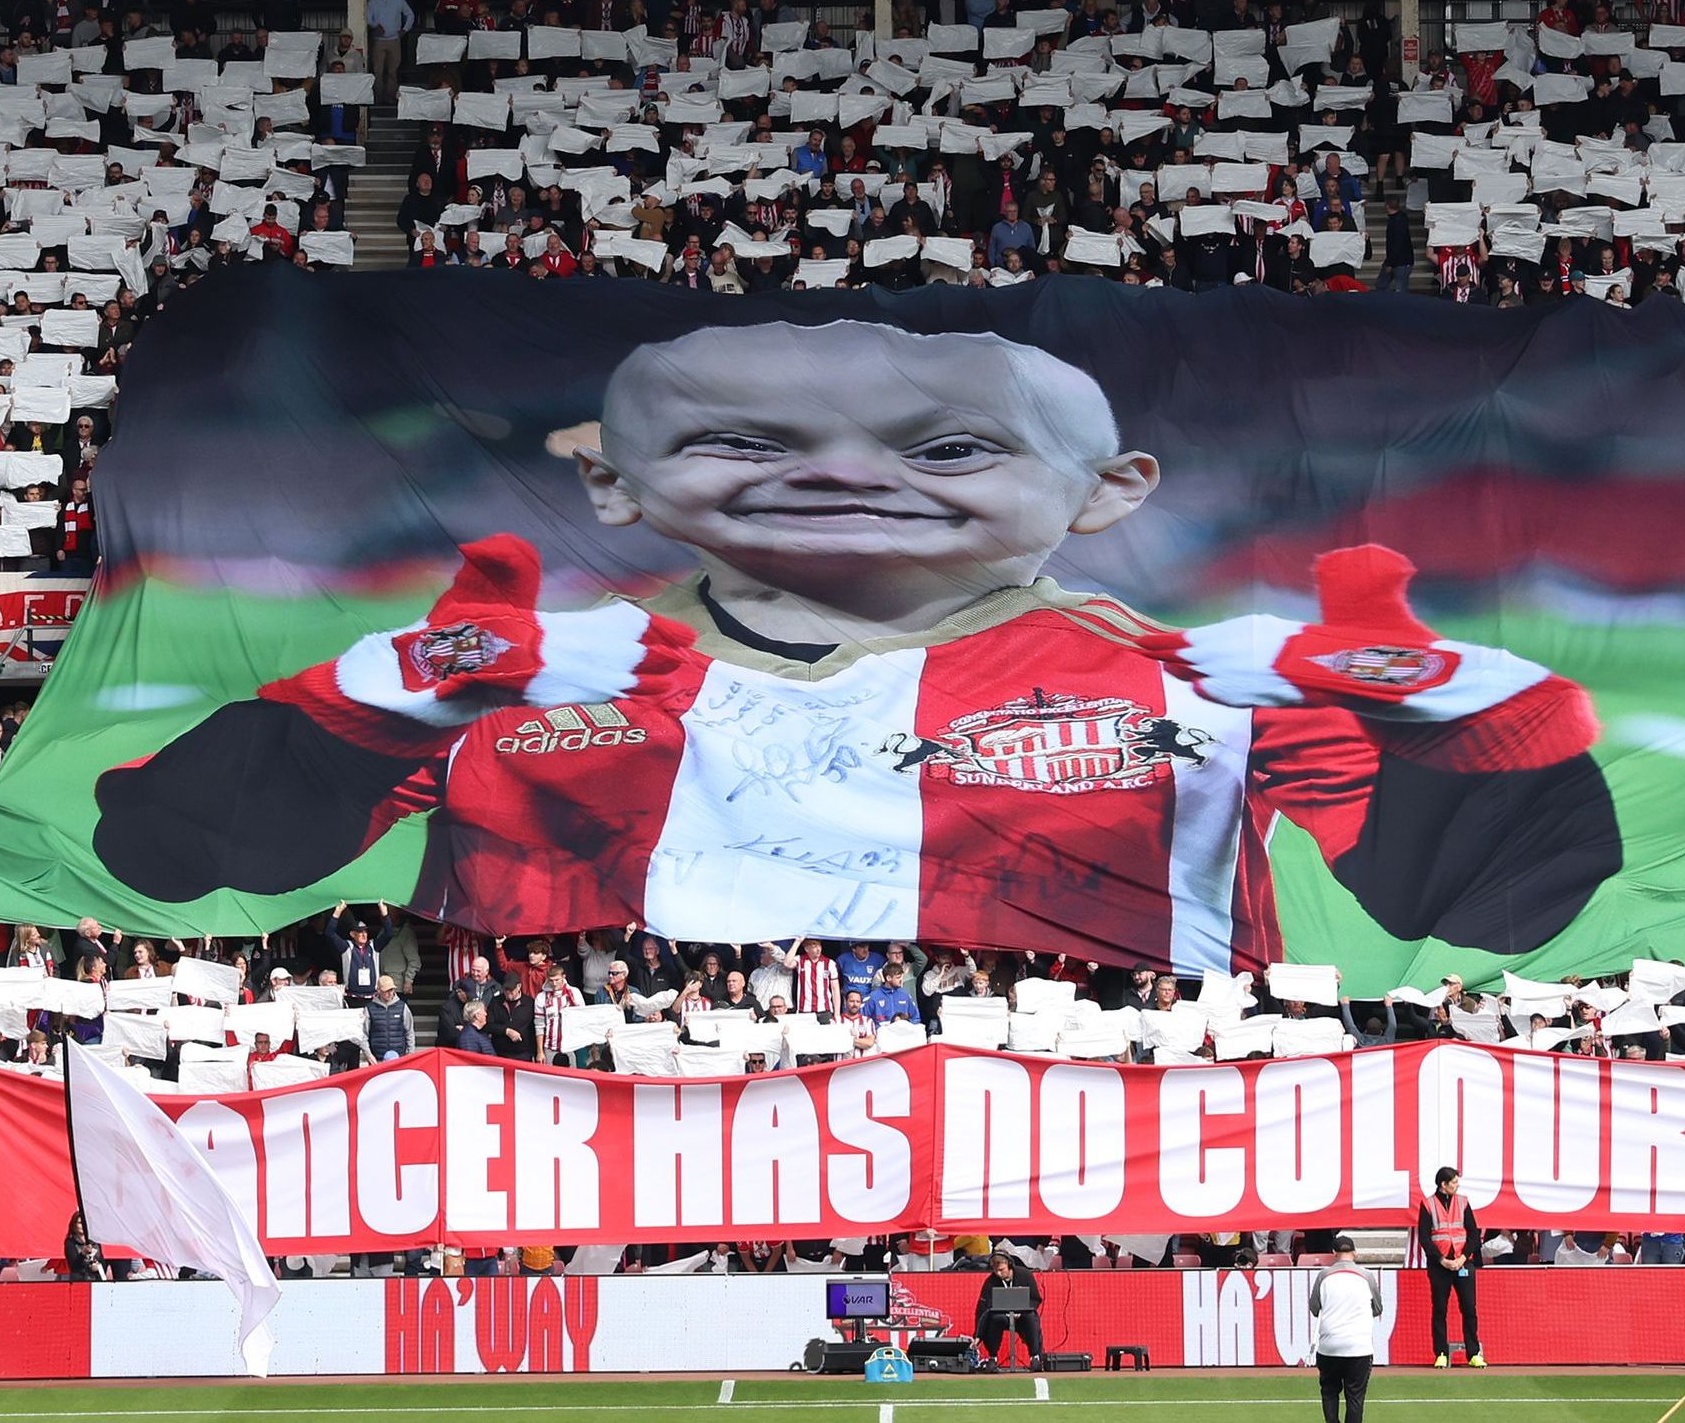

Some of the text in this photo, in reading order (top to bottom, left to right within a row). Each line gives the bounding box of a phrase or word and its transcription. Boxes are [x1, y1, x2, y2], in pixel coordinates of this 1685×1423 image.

[495, 725, 648, 755] adidas
[847, 975, 873, 984] VAUX
[175, 1066, 601, 1239] ANCER
[633, 1056, 911, 1228] HAS
[941, 1056, 1126, 1220] NO
[850, 1295, 875, 1304] VAR
[384, 1276, 600, 1375] HA'WAY
